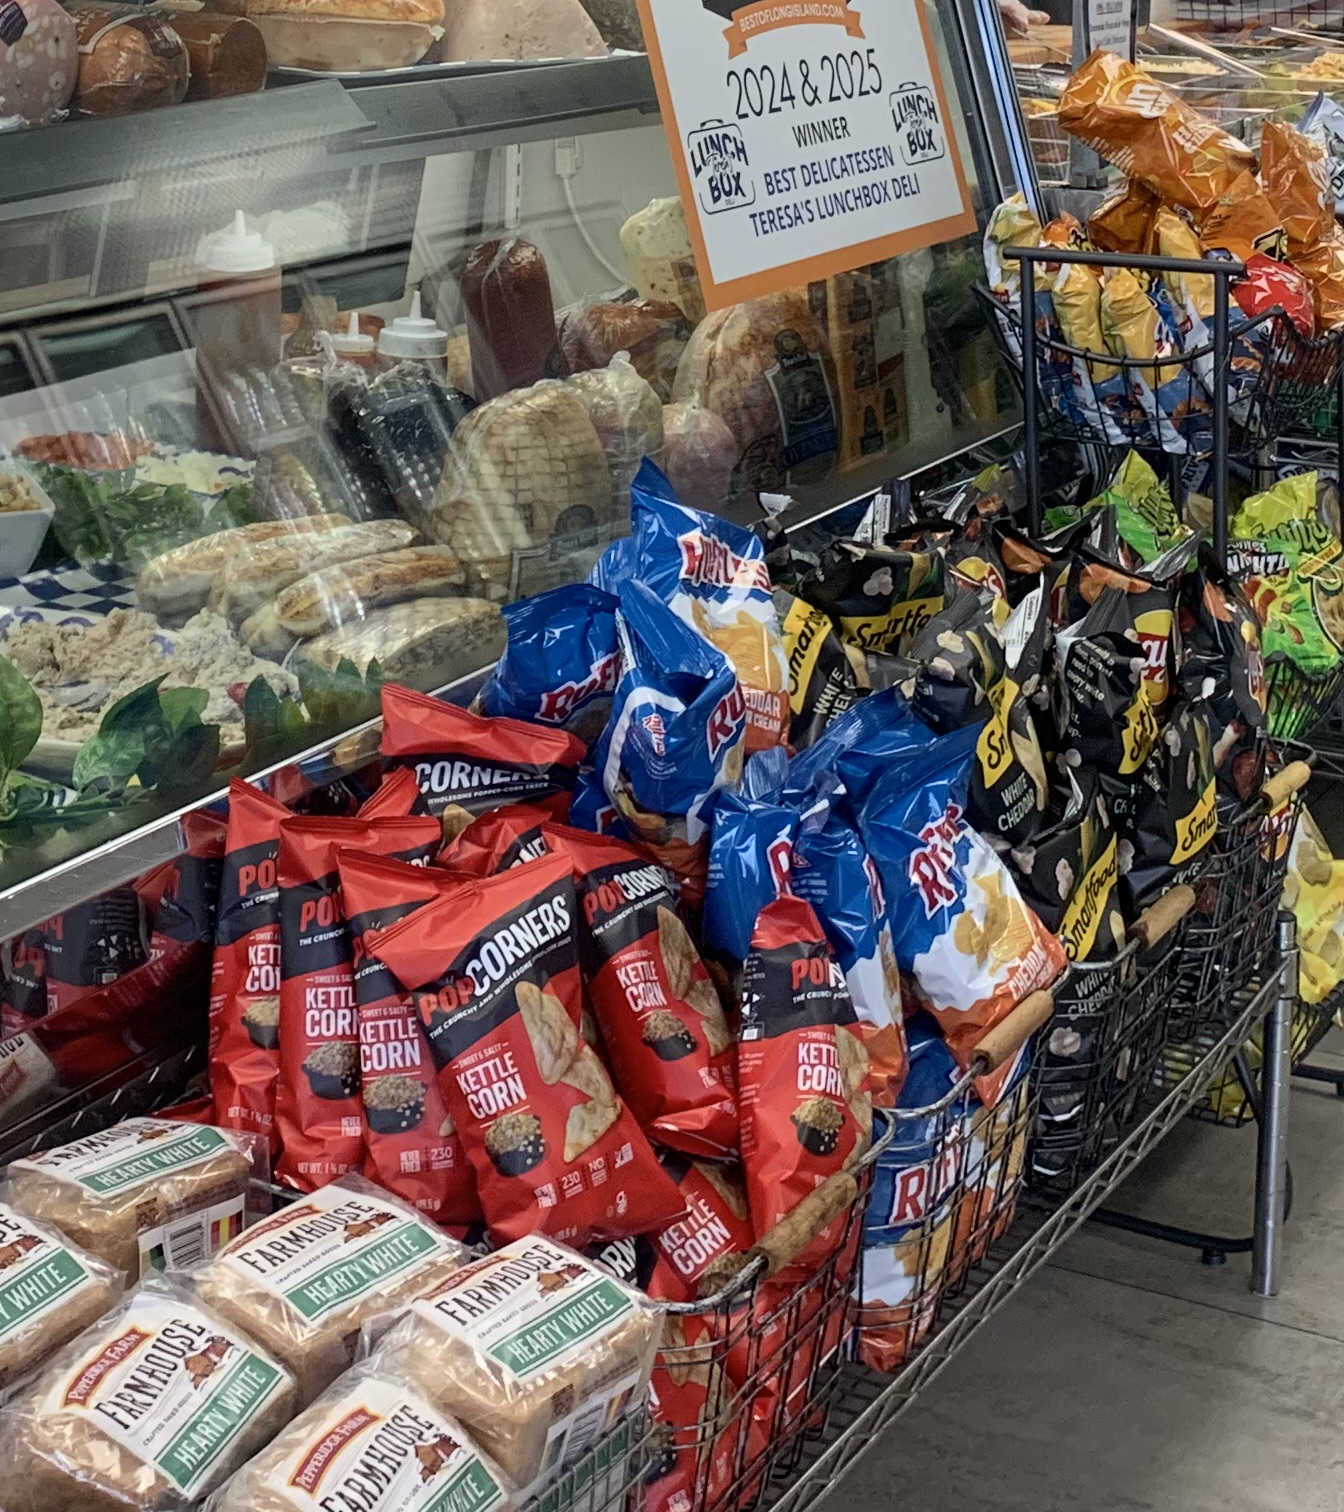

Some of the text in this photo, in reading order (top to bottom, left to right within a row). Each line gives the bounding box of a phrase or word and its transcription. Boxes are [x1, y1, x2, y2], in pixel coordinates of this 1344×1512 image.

[738, 3, 844, 33] BESTOFLONGISLAND.COM
[727, 48, 882, 120] 2024 & 2025
[792, 116, 851, 148] WINNER
[892, 94, 938, 133] LUNCH
[690, 132, 749, 178] LUNCH
[907, 128, 937, 157] BOX
[708, 170, 746, 205] BOX
[764, 144, 895, 196] BEST DELICATESSEN
[749, 173, 921, 237] TERESA'S LUNCHBOX DELI
[998, 788, 1035, 831] CHEDDAR
[1000, 772, 1028, 807] WHITE
[1064, 847, 1116, 960] Smartfood
[360, 1039, 421, 1072] CORN
[456, 1051, 518, 1095] KETTLE
[467, 1074, 527, 1119] CORN
[658, 1198, 717, 1252] KETTLE
[671, 1217, 732, 1277] CORN
[5, 1262, 67, 1311] WHITE
[94, 1319, 206, 1430] FARMHOUSE
[173, 1366, 267, 1471] HEARTY WHITE
